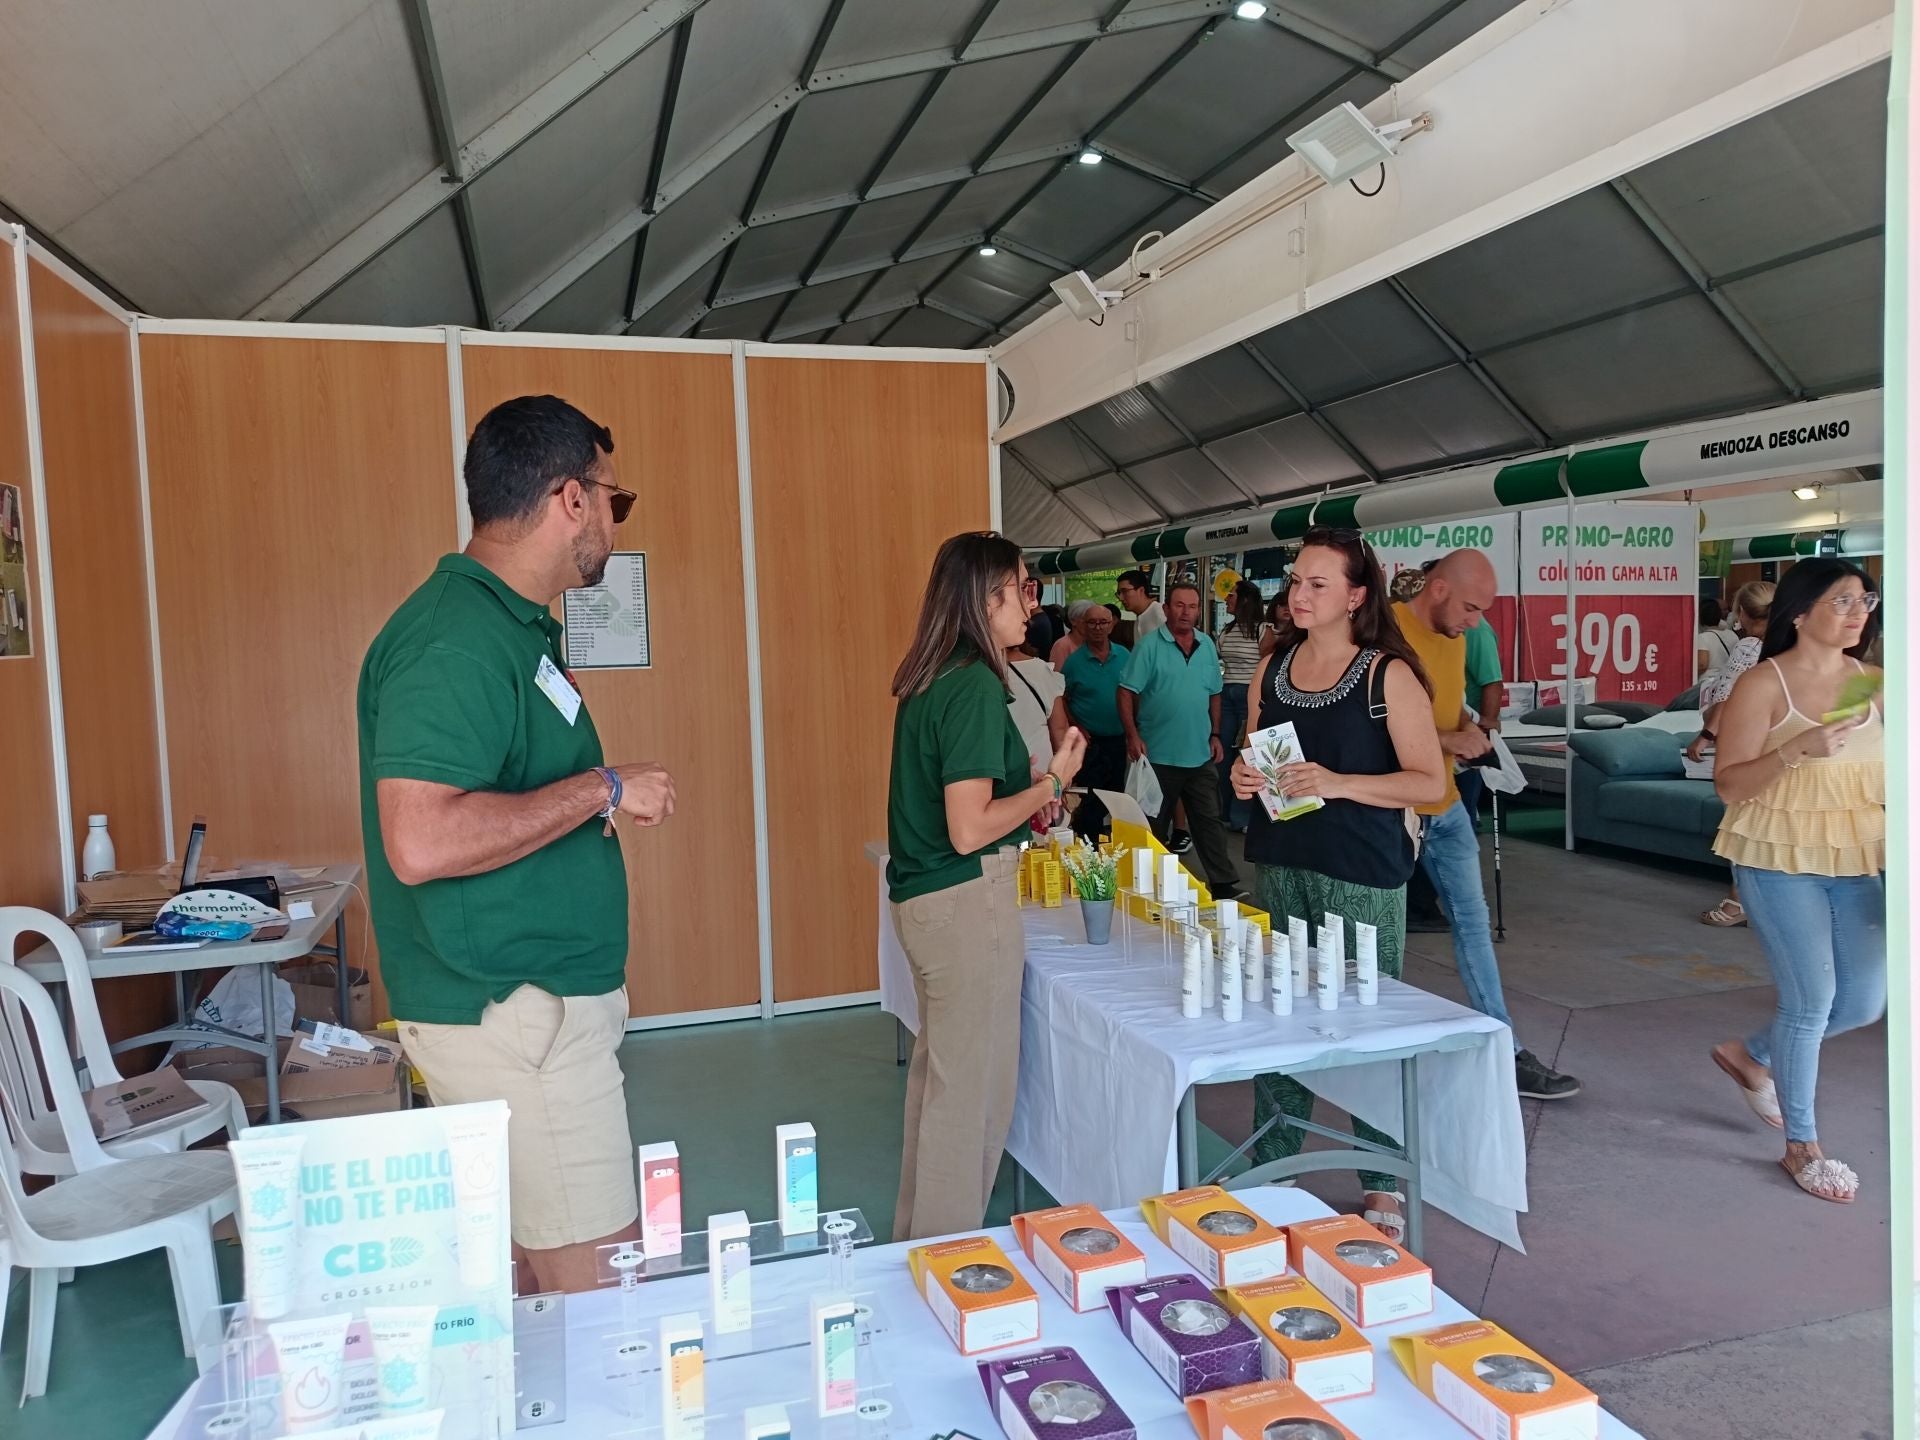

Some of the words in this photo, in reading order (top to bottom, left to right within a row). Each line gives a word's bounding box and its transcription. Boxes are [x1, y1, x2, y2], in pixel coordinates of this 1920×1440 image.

[1700, 434, 1764, 459] MENDOZA
[1768, 420, 1850, 449] DESCANSO
[1364, 525, 1494, 548] ROMO-AGRO
[1612, 566, 1645, 582] GAMA
[1650, 566, 1678, 582] ALTA
[1621, 681, 1635, 692] 135
[1643, 680, 1658, 691] 190
[171, 904, 258, 913] thermomix
[296, 1162, 337, 1199] UE
[346, 1159, 375, 1189] EL
[385, 1149, 452, 1184] DOLO
[303, 1194, 345, 1228] NO
[353, 1189, 386, 1221] TE
[395, 1181, 457, 1215] PAR
[320, 1278, 434, 1303] CROSSZION
[451, 1317, 475, 1329] FRÍO
[1012, 1357, 1040, 1367] PEACEFUL
[531, 1401, 543, 1418] CBD
[859, 1404, 888, 1414] CBD
